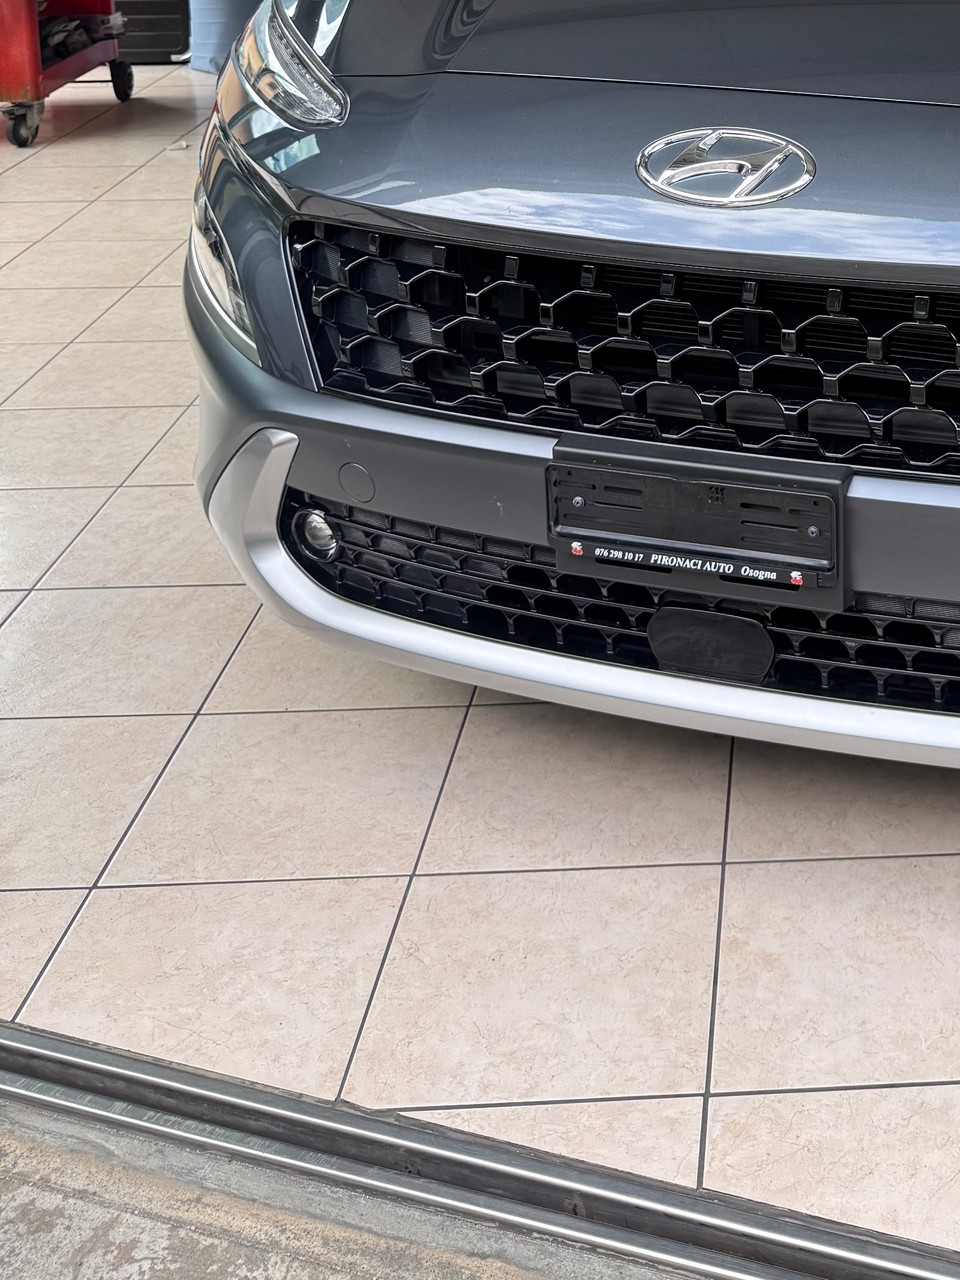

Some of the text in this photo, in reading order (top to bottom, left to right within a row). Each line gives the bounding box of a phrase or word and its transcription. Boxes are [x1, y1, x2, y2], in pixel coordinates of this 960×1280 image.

[594, 547, 777, 580] 076 298 10 17 PIRONACI AUTO Osogna
